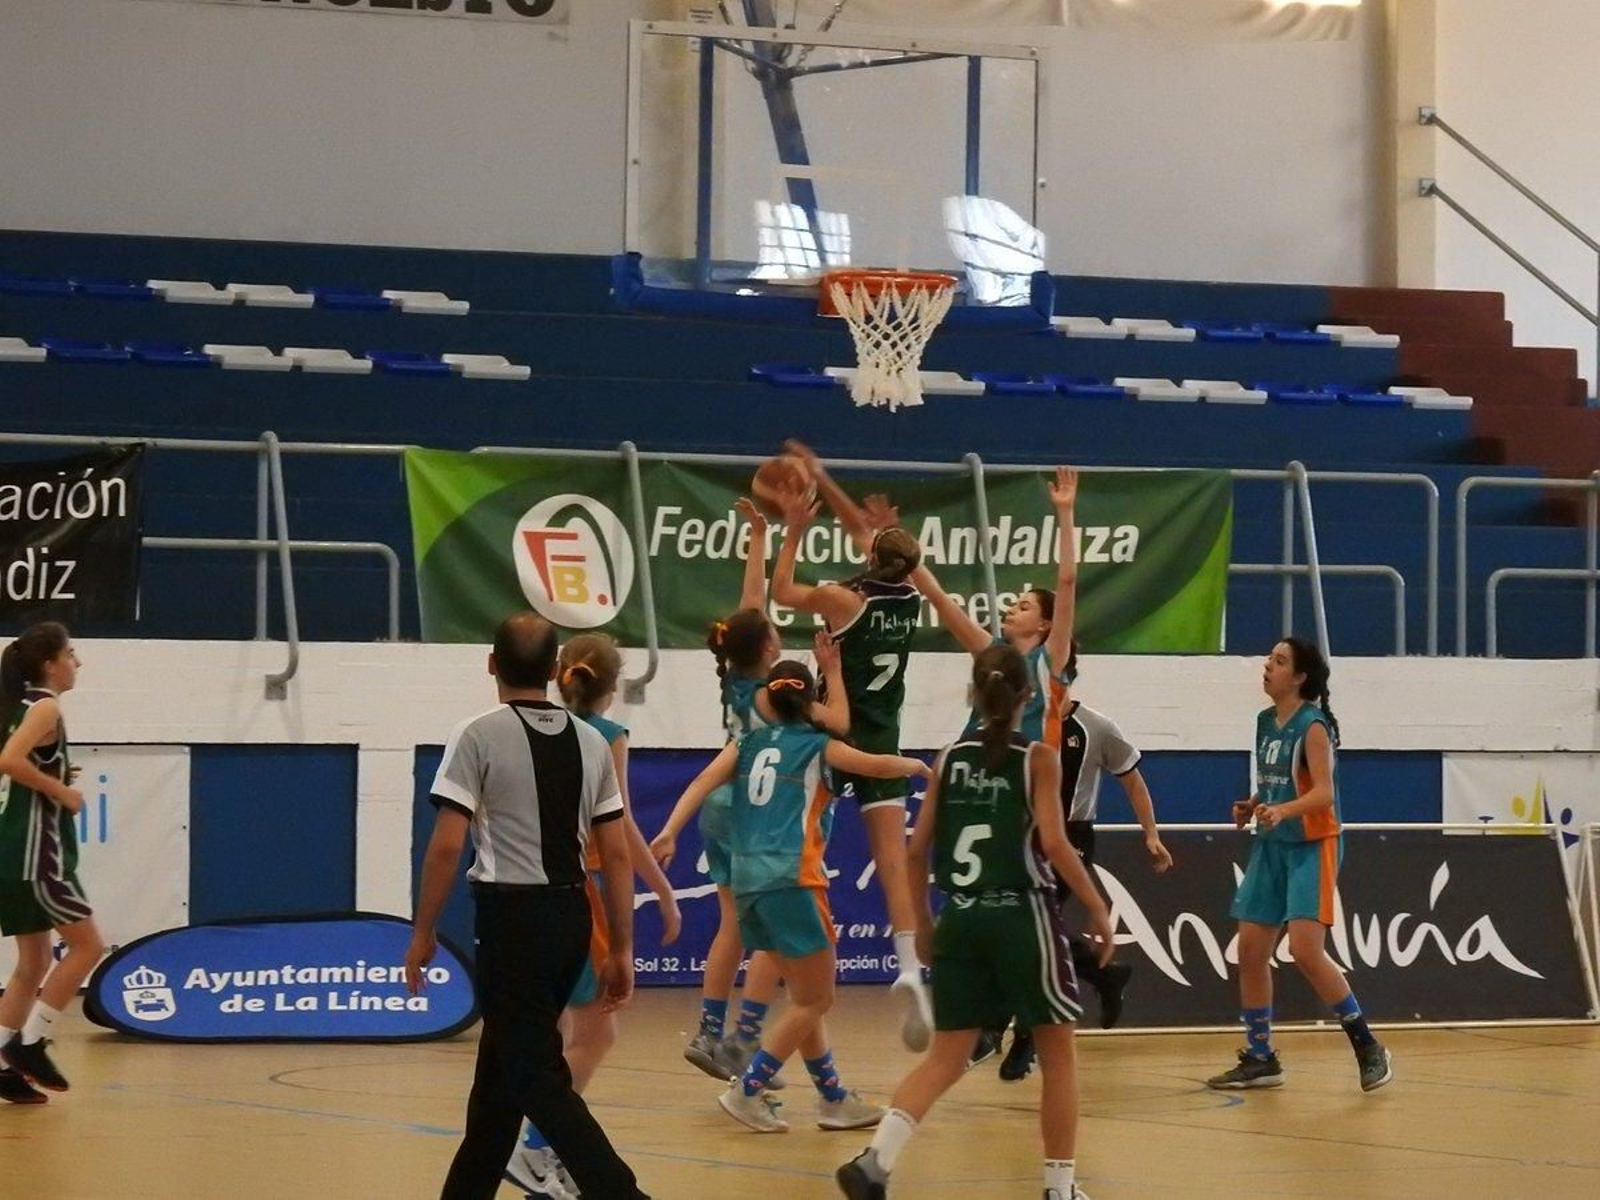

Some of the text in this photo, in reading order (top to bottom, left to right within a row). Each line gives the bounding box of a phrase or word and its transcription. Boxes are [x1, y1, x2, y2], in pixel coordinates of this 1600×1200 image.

[920, 515, 1140, 565] Andaluza
[866, 653, 900, 692] 7
[748, 748, 781, 806] 6
[950, 823, 992, 887] 5
[634, 957, 658, 972] Sol
[661, 957, 680, 972] 32
[219, 990, 429, 1013] de La Línea
